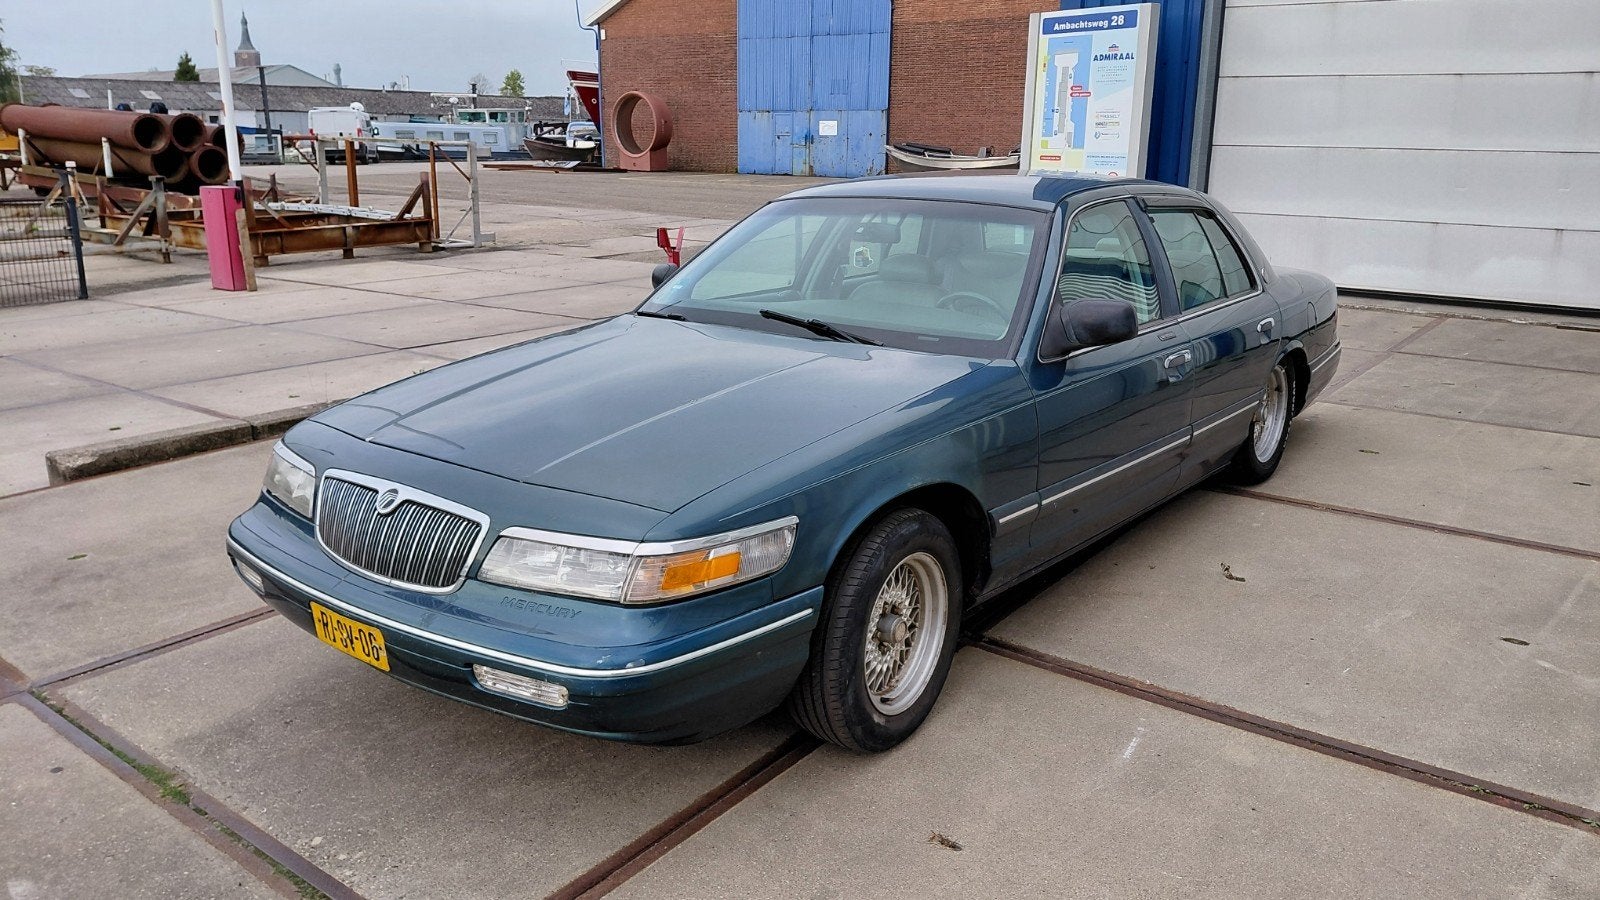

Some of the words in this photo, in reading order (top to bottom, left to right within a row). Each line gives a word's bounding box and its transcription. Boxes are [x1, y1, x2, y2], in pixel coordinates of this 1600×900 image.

[1053, 20, 1108, 31] Ambachtsweg
[1111, 15, 1125, 26] 28
[1093, 52, 1135, 62] ADMIRAAL
[499, 596, 582, 619] MERCURY
[319, 610, 380, 662] RJ-SV-06
